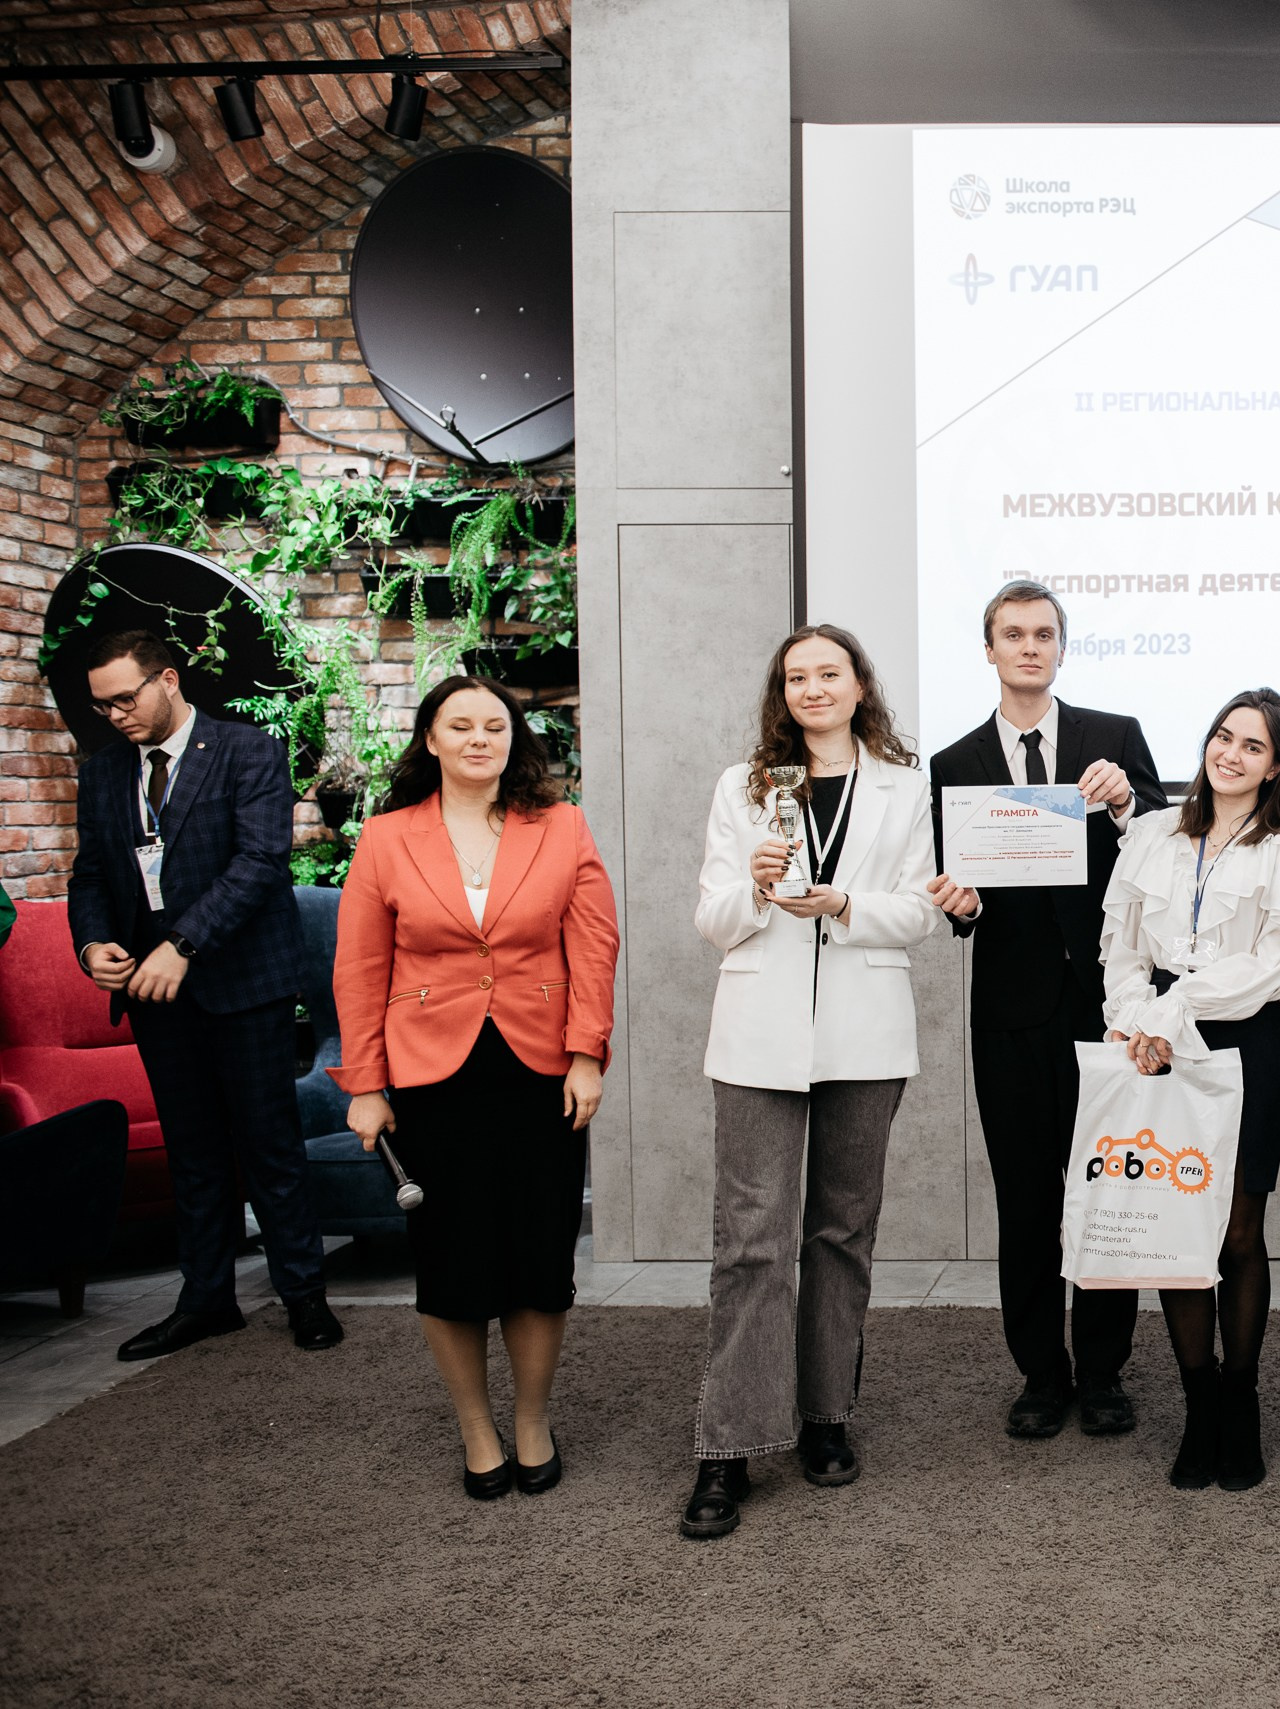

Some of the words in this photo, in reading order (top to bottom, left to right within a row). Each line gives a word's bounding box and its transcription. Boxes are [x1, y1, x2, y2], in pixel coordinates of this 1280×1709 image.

[1005, 177, 1071, 194] Школа
[1005, 200, 1094, 218] экспорта
[1098, 197, 1137, 216] РЭЦ
[1009, 264, 1099, 293] ГУАП
[1074, 391, 1095, 413] II
[1002, 485, 1257, 519] МЕЖВУЗОВСКИЙ
[1068, 632, 1126, 662] ября
[1132, 632, 1192, 656] 2023
[990, 809, 1039, 817] ГРАМОТА
[1180, 1165, 1204, 1177] ТРЕК
[1099, 1209, 1116, 1220] (921)
[1117, 1211, 1159, 1221] 330-25-68
